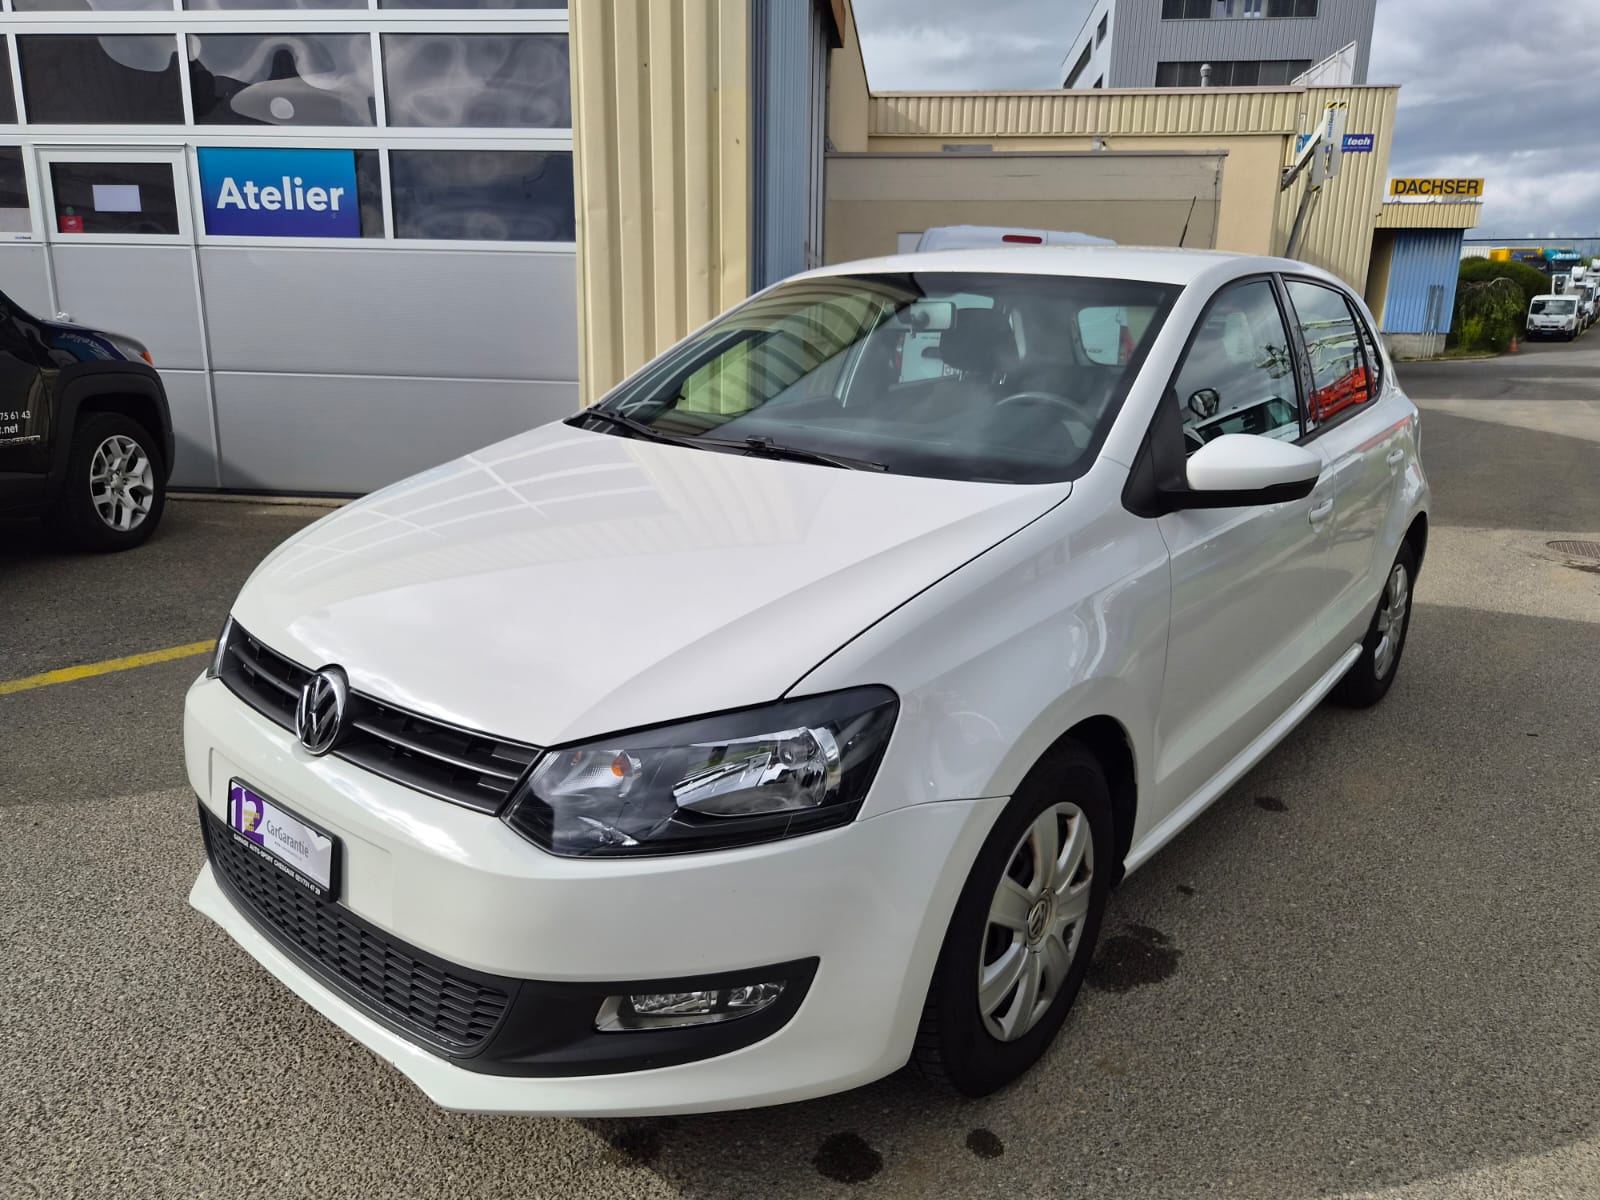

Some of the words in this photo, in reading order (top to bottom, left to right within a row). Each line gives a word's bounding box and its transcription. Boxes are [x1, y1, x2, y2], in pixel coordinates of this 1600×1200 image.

[1342, 137, 1371, 146] ltech
[216, 176, 345, 211] Atelier
[1394, 179, 1479, 195] DACHSER
[10, 410, 19, 420] 61
[21, 410, 31, 419] 43
[266, 820, 309, 858] CarGarantie
